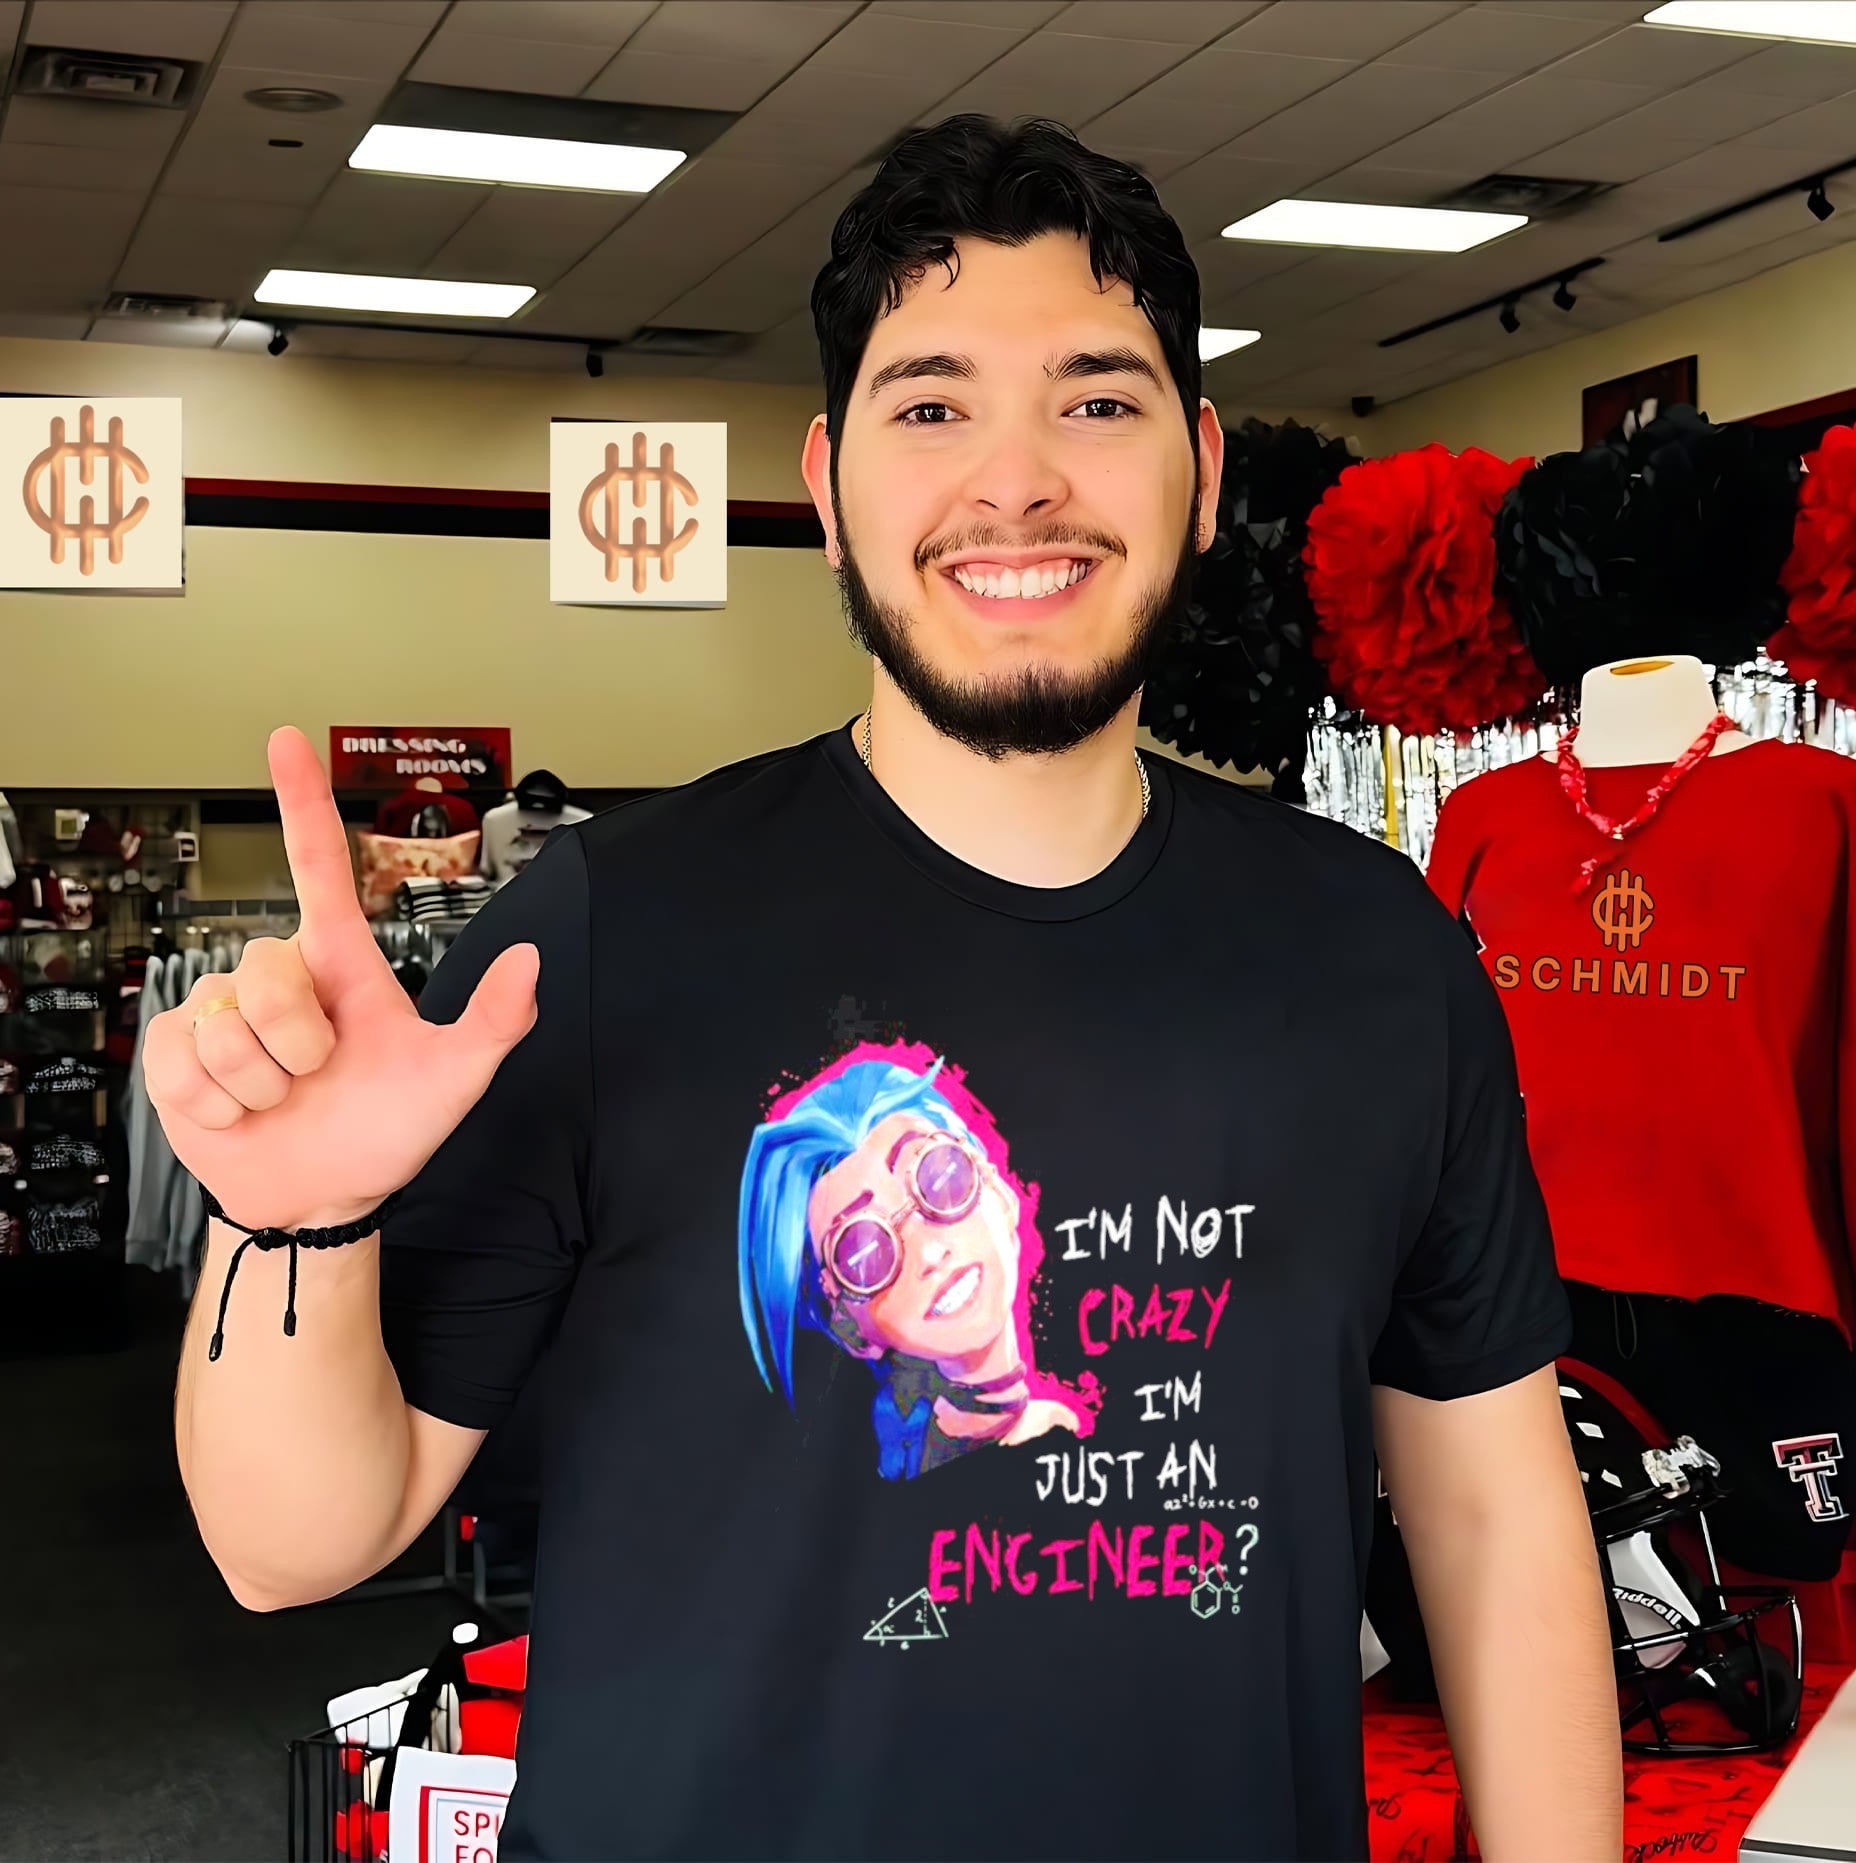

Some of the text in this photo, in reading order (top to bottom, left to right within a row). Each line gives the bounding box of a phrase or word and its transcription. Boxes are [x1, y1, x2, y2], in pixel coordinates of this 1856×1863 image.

[342, 737, 467, 754] DRESSING
[396, 759, 487, 775] ROOMS
[1494, 953, 1747, 1000] SCHMIDT
[1055, 1194, 1256, 1266] I'M NOT
[1078, 1278, 1231, 1356] CRAZY
[1133, 1370, 1202, 1422] I'M
[1035, 1438, 1218, 1506] JUST AN
